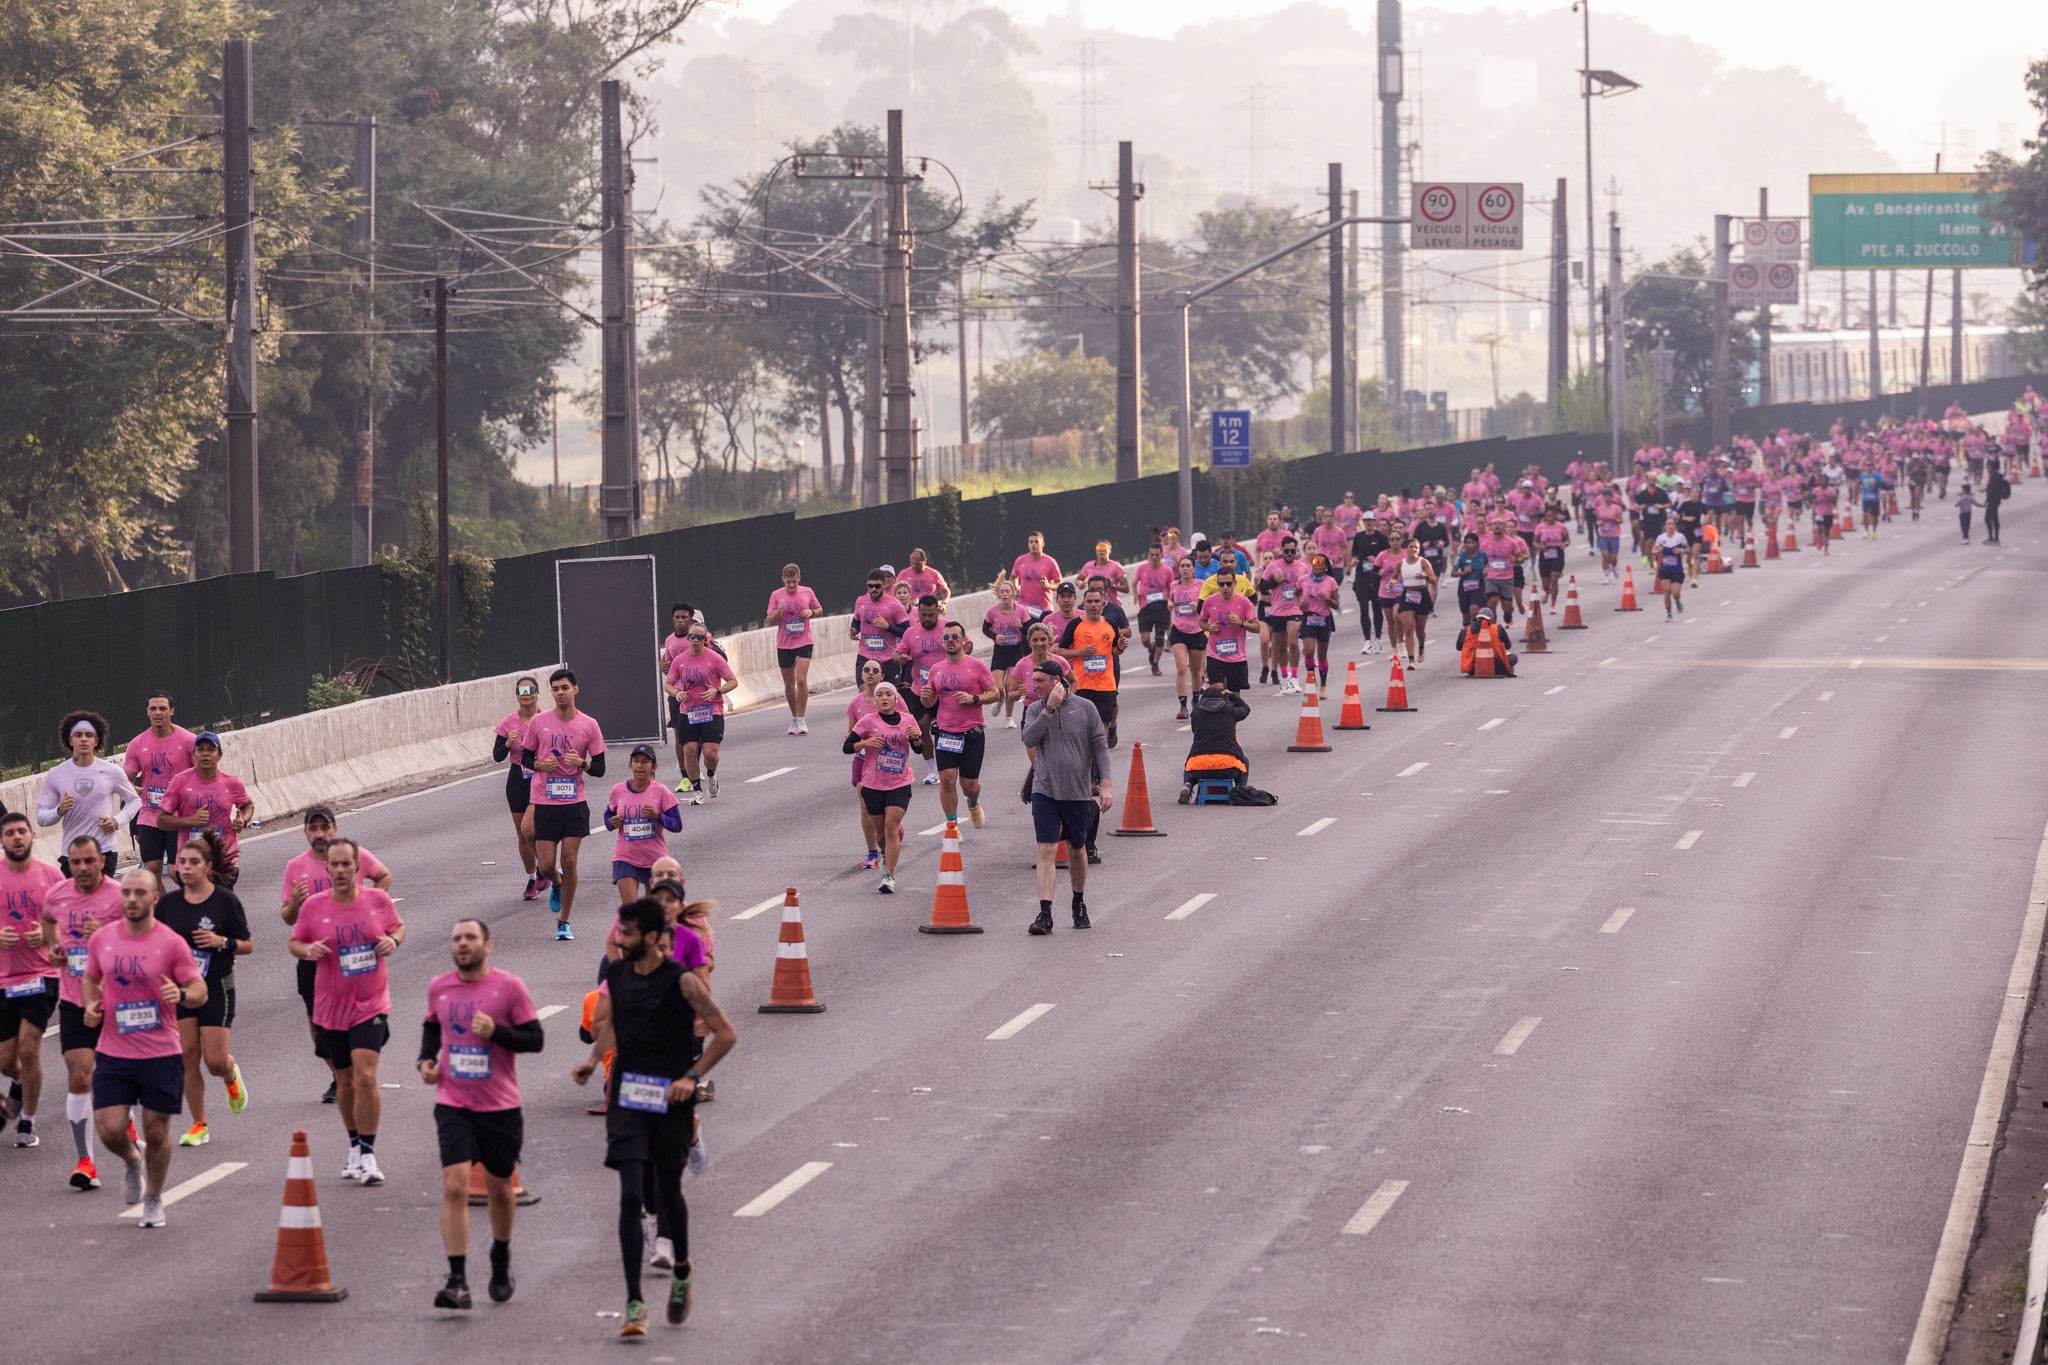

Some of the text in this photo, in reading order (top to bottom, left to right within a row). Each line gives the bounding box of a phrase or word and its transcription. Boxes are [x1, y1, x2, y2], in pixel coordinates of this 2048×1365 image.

[1428, 194, 1449, 208] 90
[1485, 194, 1507, 208] 60
[1845, 202, 1979, 215] Av. Bandeirantes
[1940, 223, 1980, 236] Itaim
[1425, 238, 1451, 247] LEVE
[1473, 239, 1516, 248] PESADO
[1914, 244, 1980, 257] ZUCCOLO
[1219, 416, 1242, 427] km
[1222, 429, 1240, 445] 12
